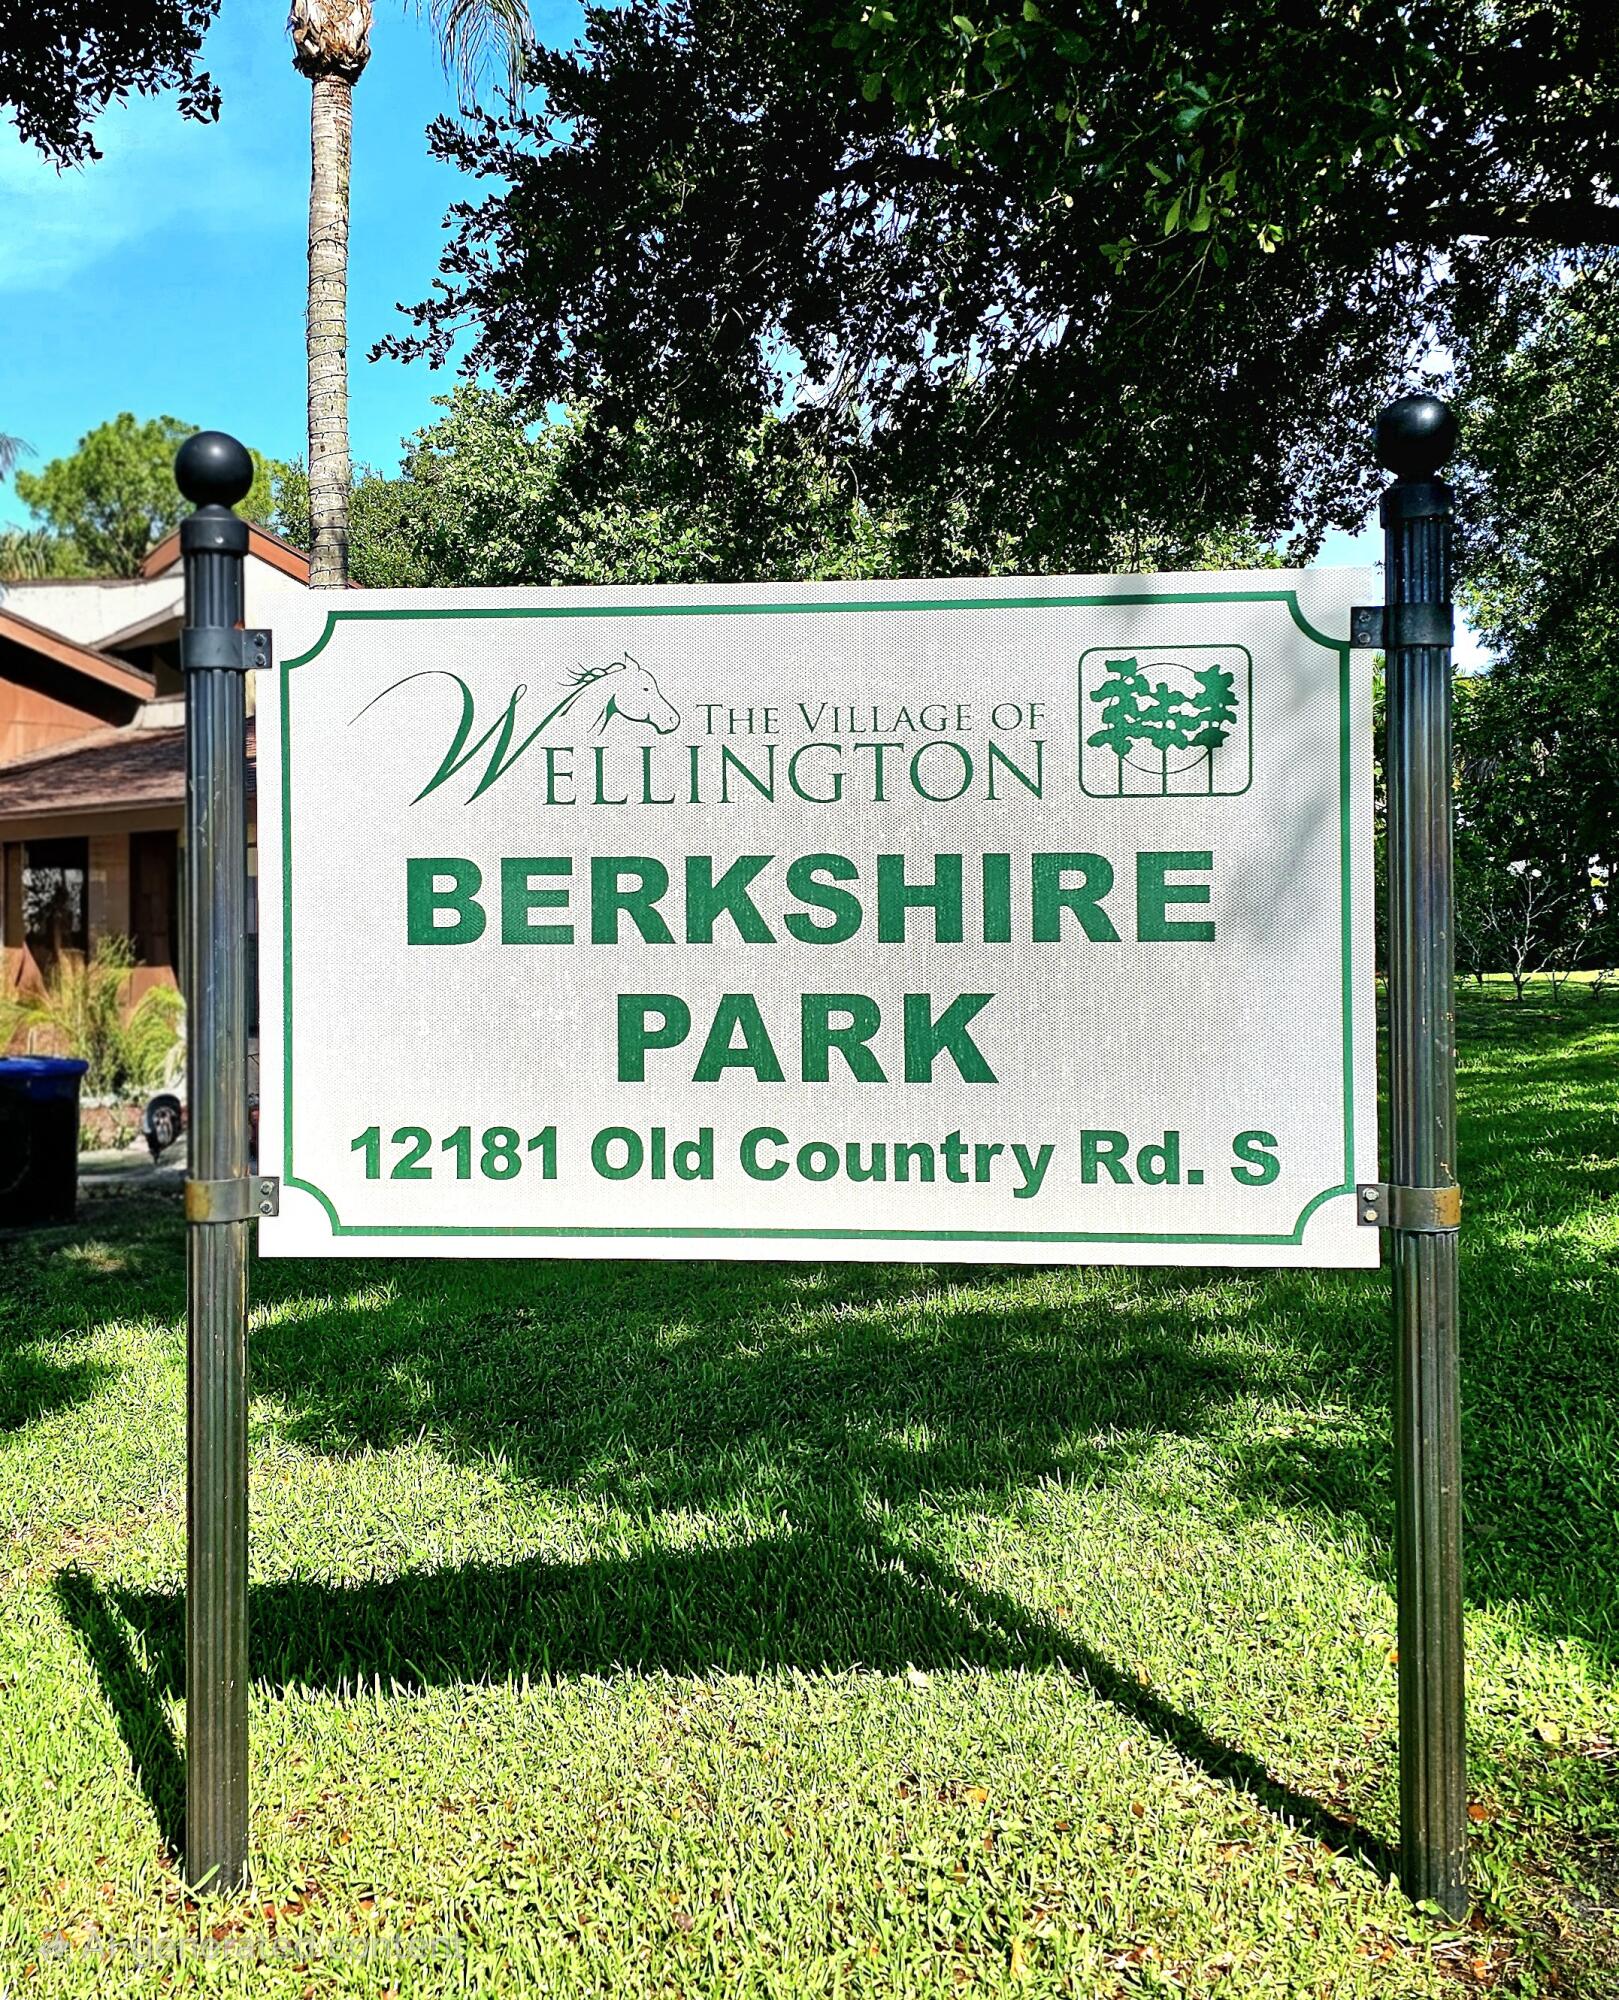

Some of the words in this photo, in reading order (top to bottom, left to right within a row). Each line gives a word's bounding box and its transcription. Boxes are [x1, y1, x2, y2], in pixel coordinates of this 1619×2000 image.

[348, 668, 1046, 806] WELLINGTON
[406, 850, 1216, 946] BERKSHIRE
[617, 993, 998, 1084] PARK
[350, 1126, 558, 1181] 12181
[590, 1127, 714, 1181] Old
[739, 1128, 1054, 1199] Country
[1079, 1130, 1204, 1187] Rd.
[1231, 1131, 1281, 1187] S
